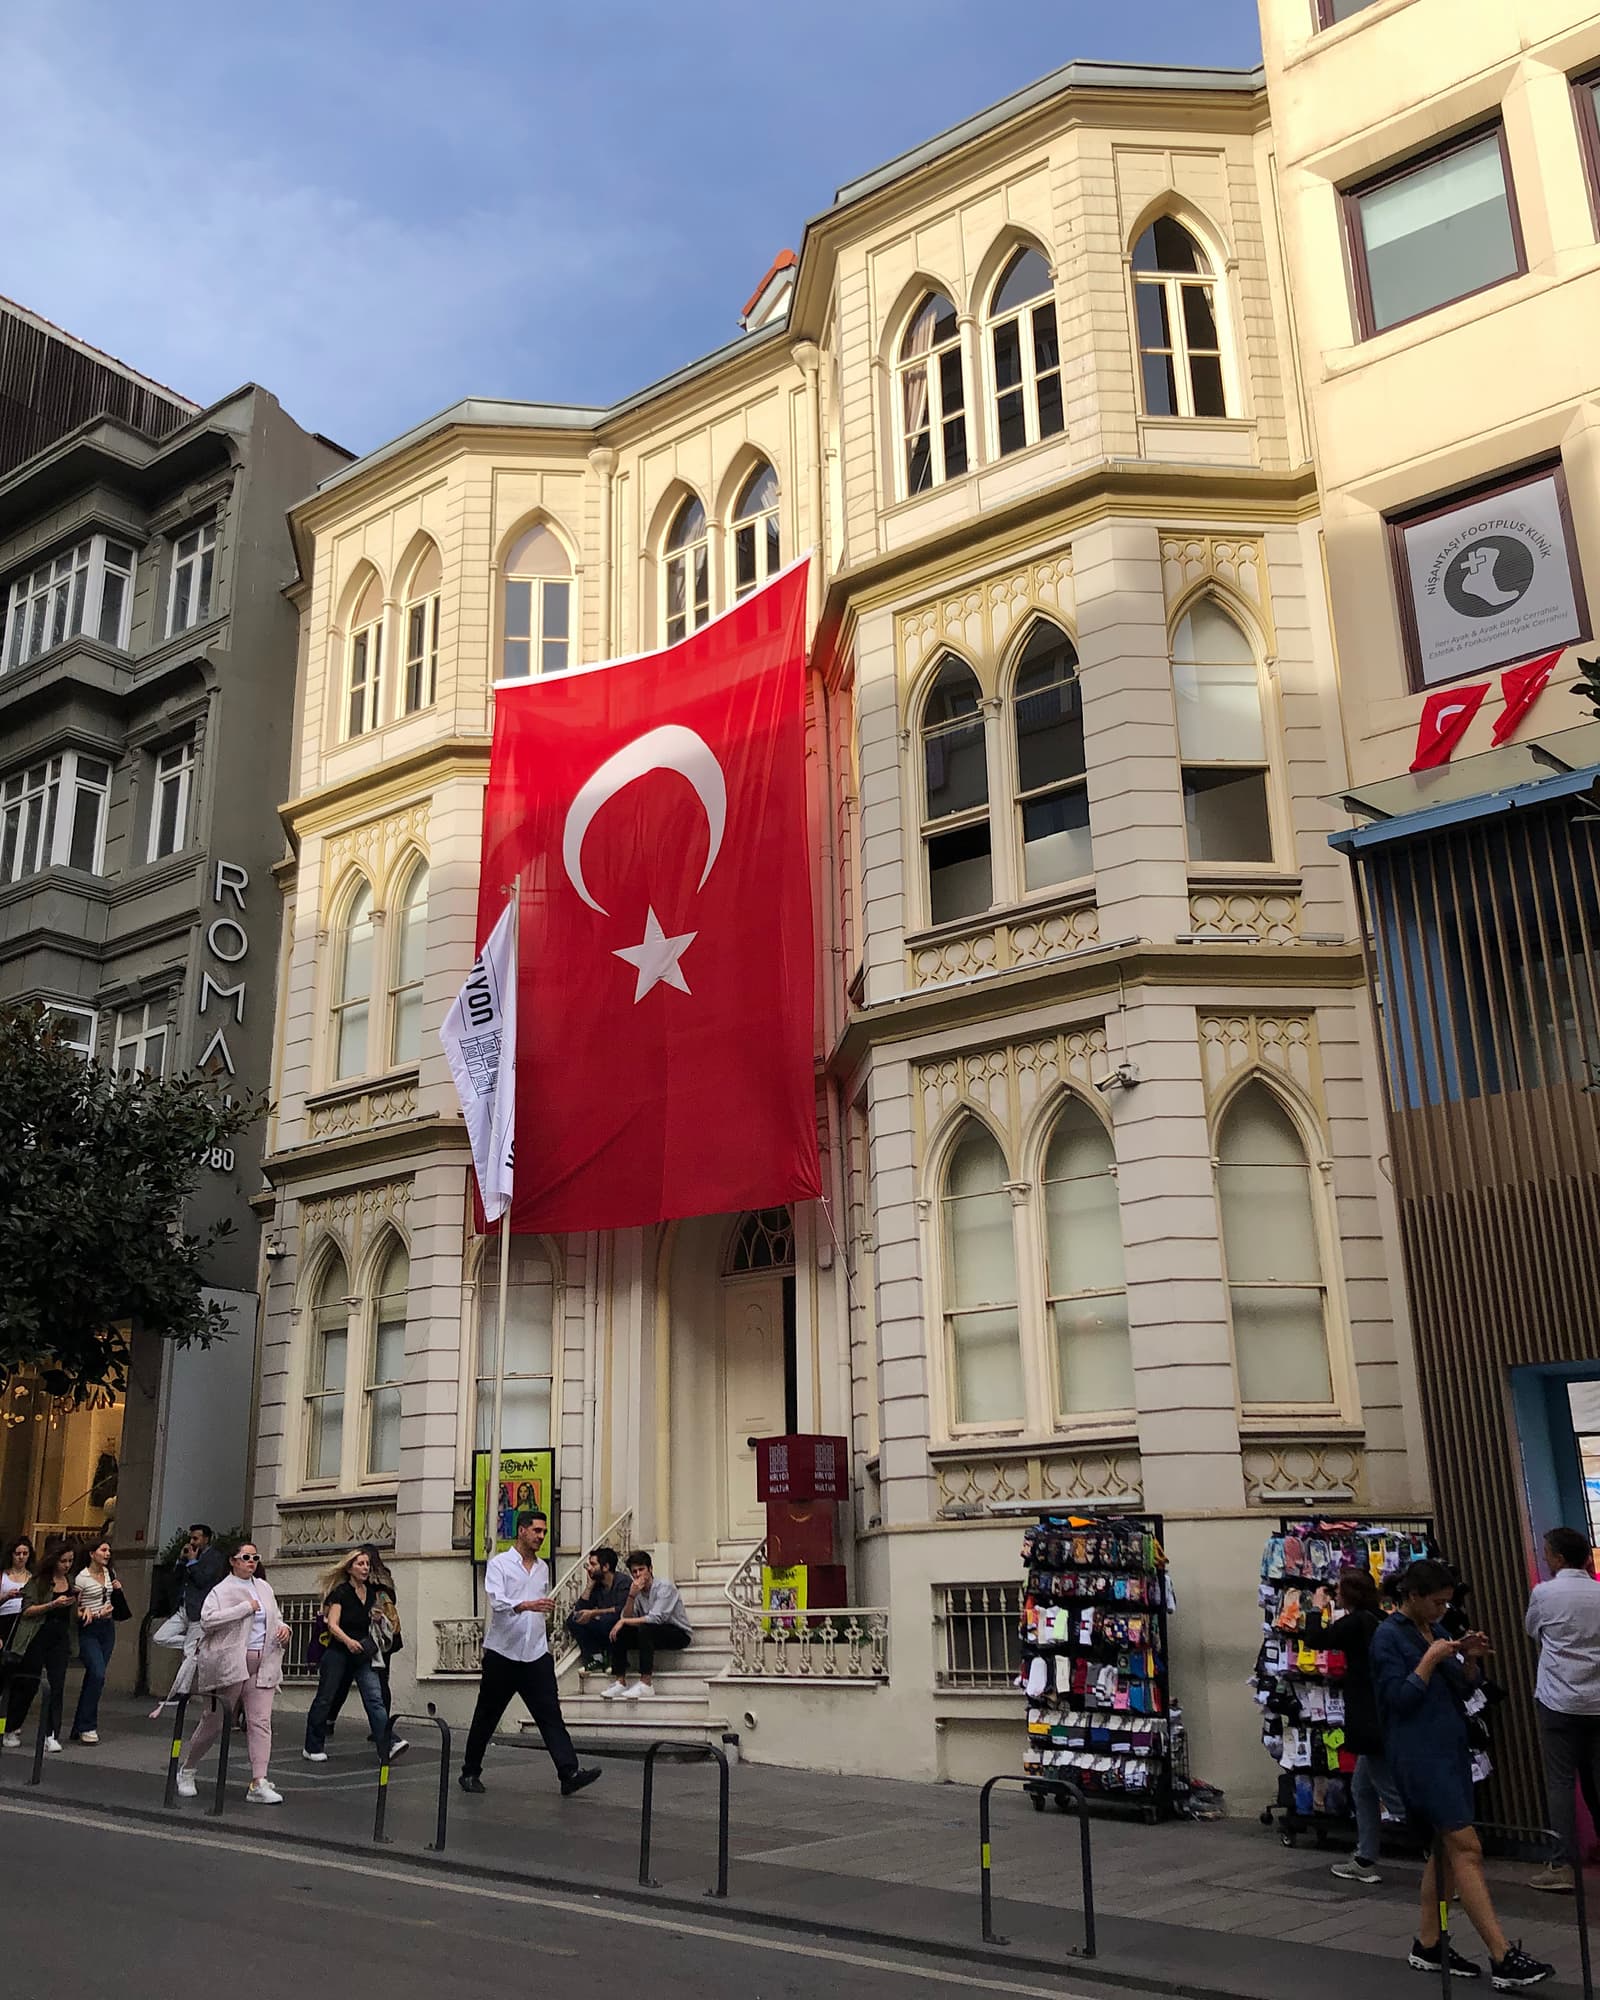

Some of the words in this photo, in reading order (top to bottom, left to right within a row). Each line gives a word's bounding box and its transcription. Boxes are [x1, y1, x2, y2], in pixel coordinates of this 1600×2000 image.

[1461, 519, 1526, 540] FOOTPLUS
[1525, 526, 1552, 559] KLİNİK
[191, 1145, 236, 1172] 80
